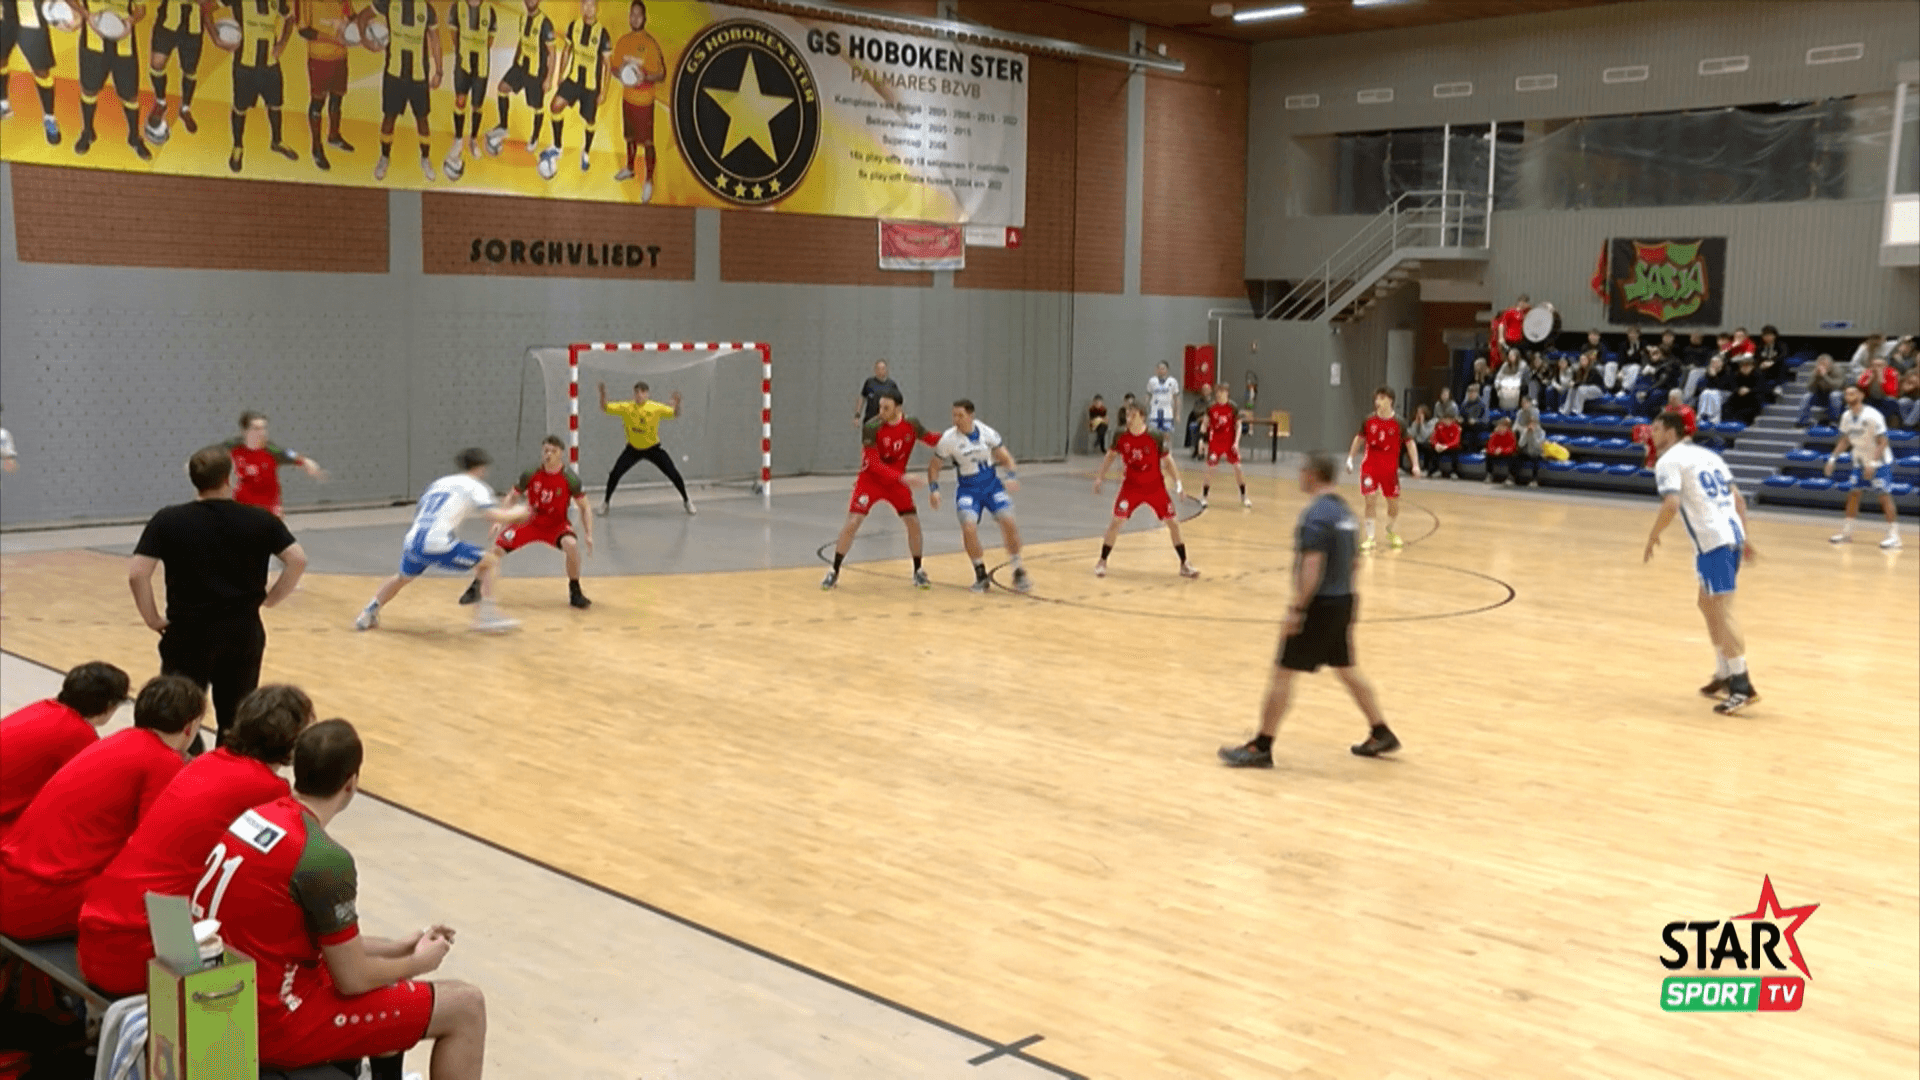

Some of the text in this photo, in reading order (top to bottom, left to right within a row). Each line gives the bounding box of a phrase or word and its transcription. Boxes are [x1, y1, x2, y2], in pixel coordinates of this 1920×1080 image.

[686, 28, 815, 103] GS HOBOKEN STER
[807, 28, 1023, 83] GS HOBOKEN STER
[851, 65, 981, 99] PALMARES BZVB
[470, 238, 662, 268] SORGHVLIEDT
[1009, 230, 1017, 244] A
[191, 843, 245, 921] 21
